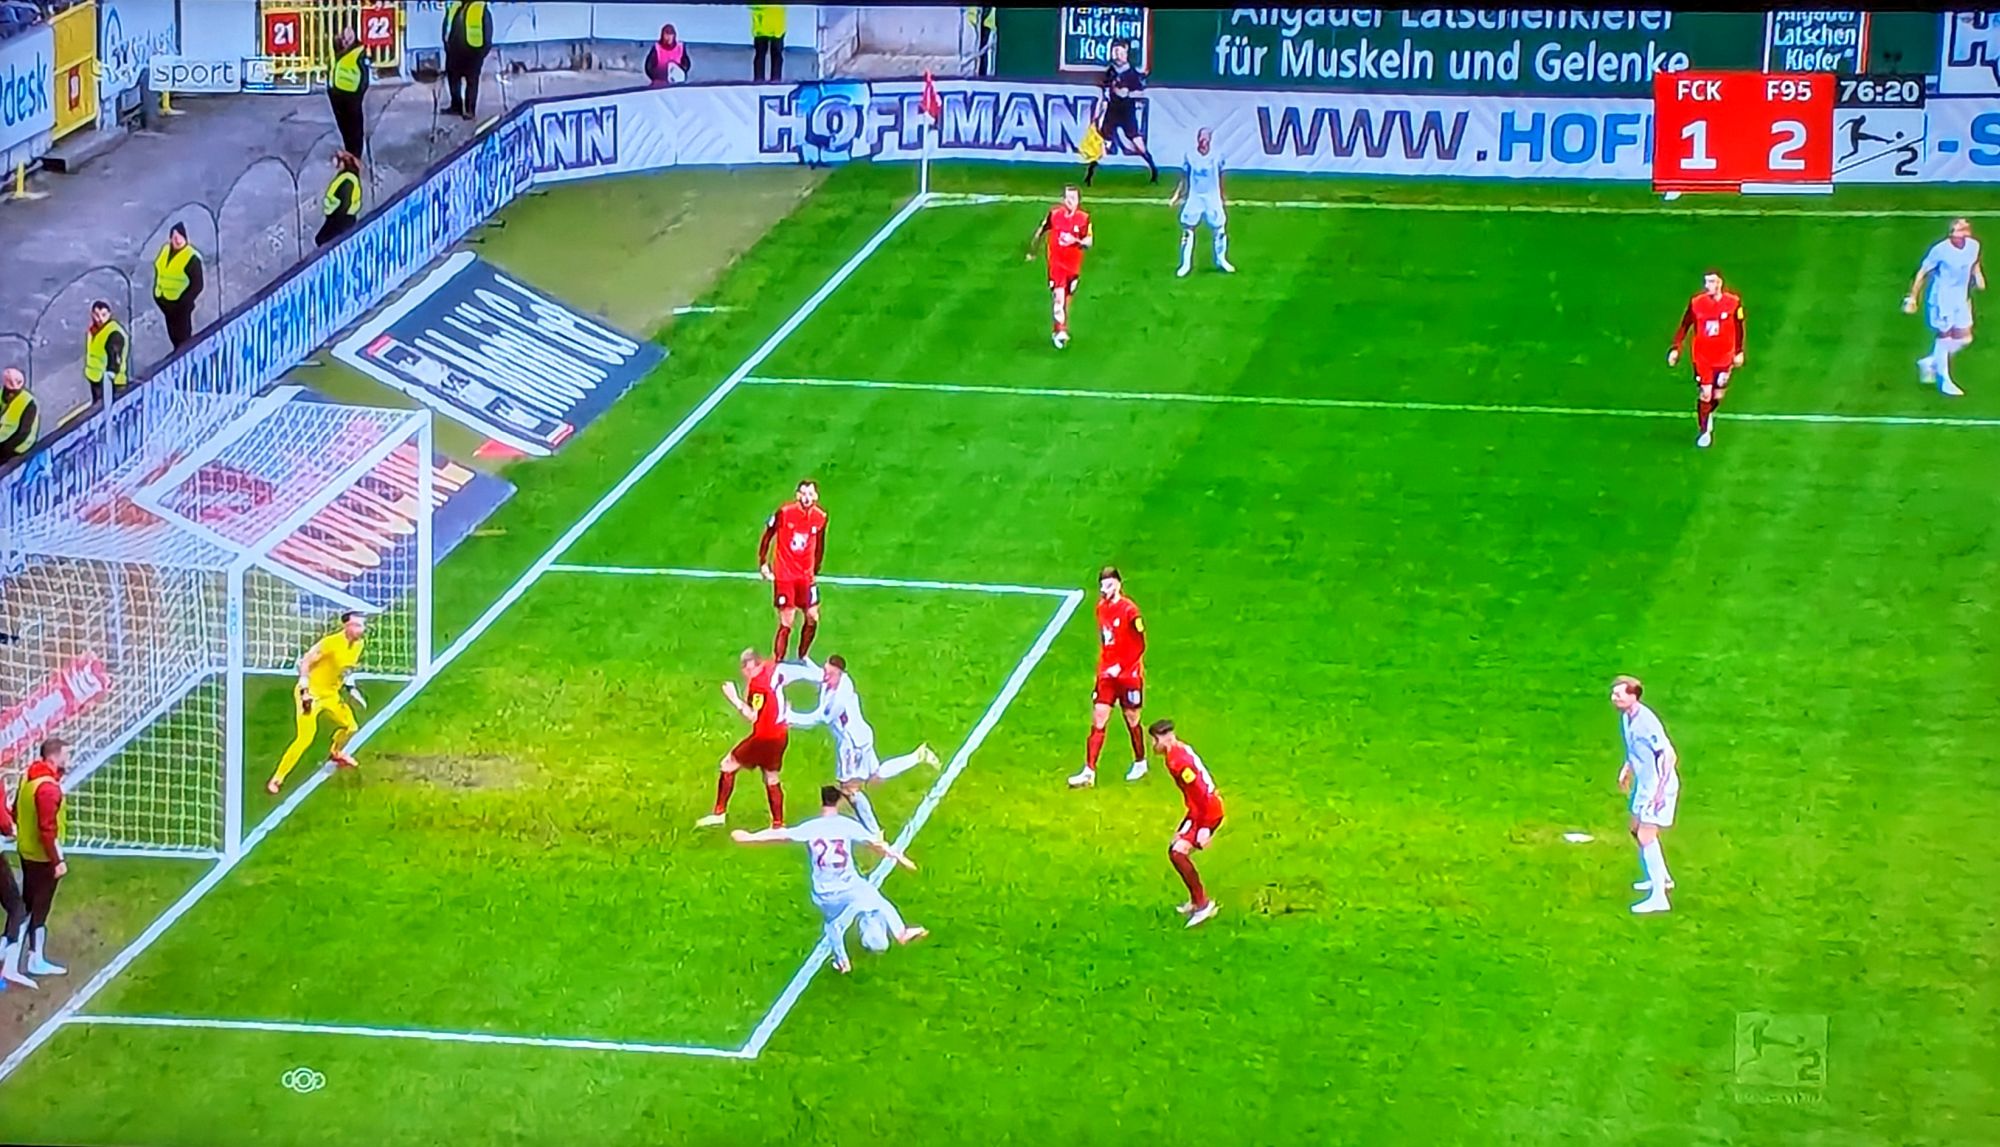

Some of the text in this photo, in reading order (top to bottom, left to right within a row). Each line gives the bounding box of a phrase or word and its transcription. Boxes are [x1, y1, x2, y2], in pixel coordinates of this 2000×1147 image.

[274, 22, 294, 45] 21
[367, 16, 390, 39] 22
[1774, 22, 1856, 46] Latschen
[1215, 35, 1690, 82] für Muskeln und Gelenke
[0, 51, 48, 127] desk
[1257, 106, 1652, 164] WWW.HOF
[813, 838, 849, 869] 23
